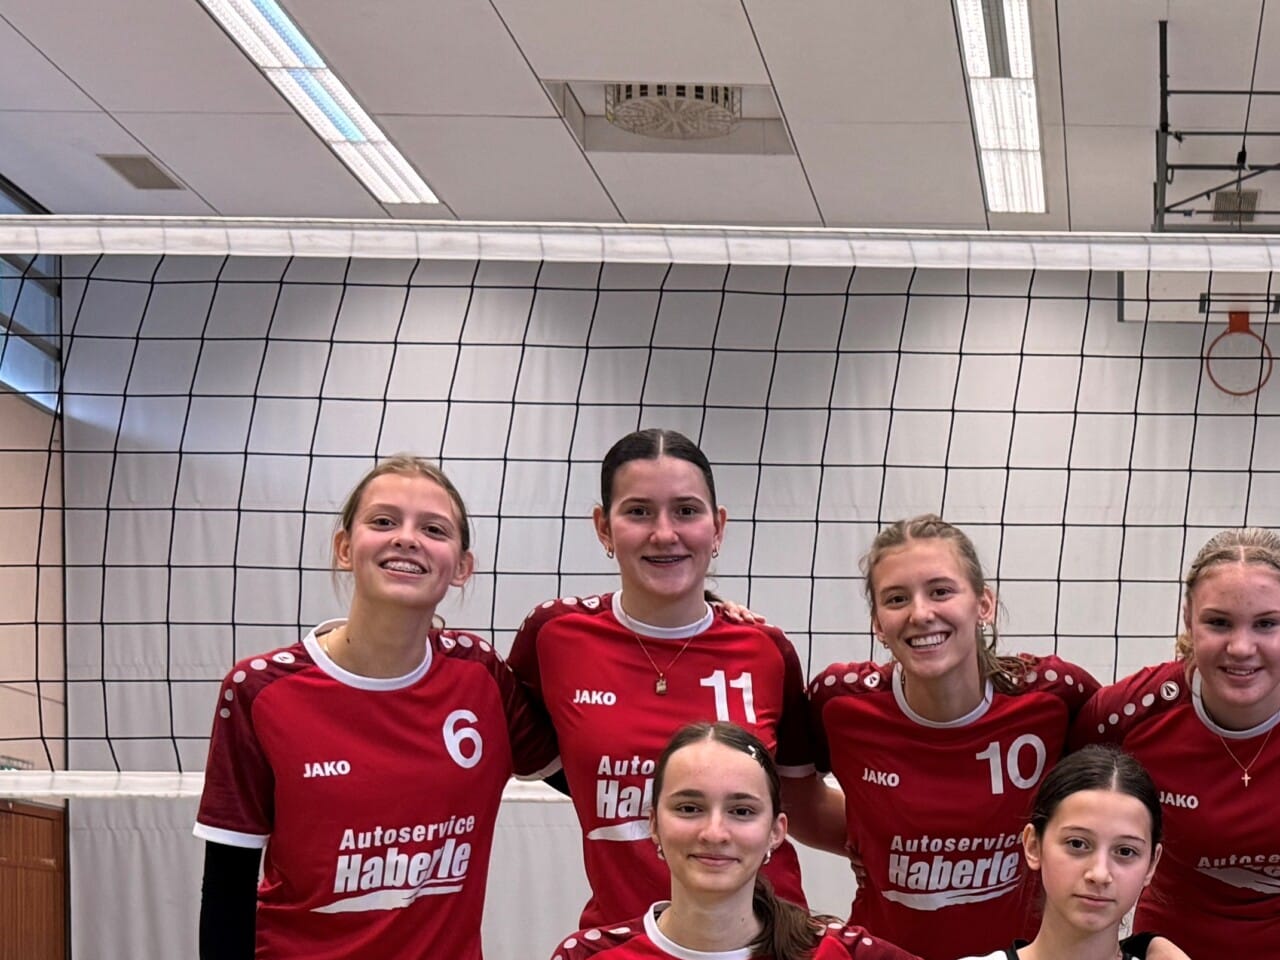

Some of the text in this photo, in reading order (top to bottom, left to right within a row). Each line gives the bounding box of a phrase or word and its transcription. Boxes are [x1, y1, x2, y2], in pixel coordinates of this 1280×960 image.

[573, 689, 617, 706] JAKO
[700, 669, 757, 723] 11
[441, 708, 483, 769] 6
[303, 759, 351, 779] JAKO
[862, 767, 900, 788] JAKO
[976, 733, 1047, 795] 10
[1159, 791, 1199, 809] JAKO
[339, 814, 476, 850] Autoservice
[333, 840, 472, 893] Haberle
[888, 851, 1020, 890] Haberle
